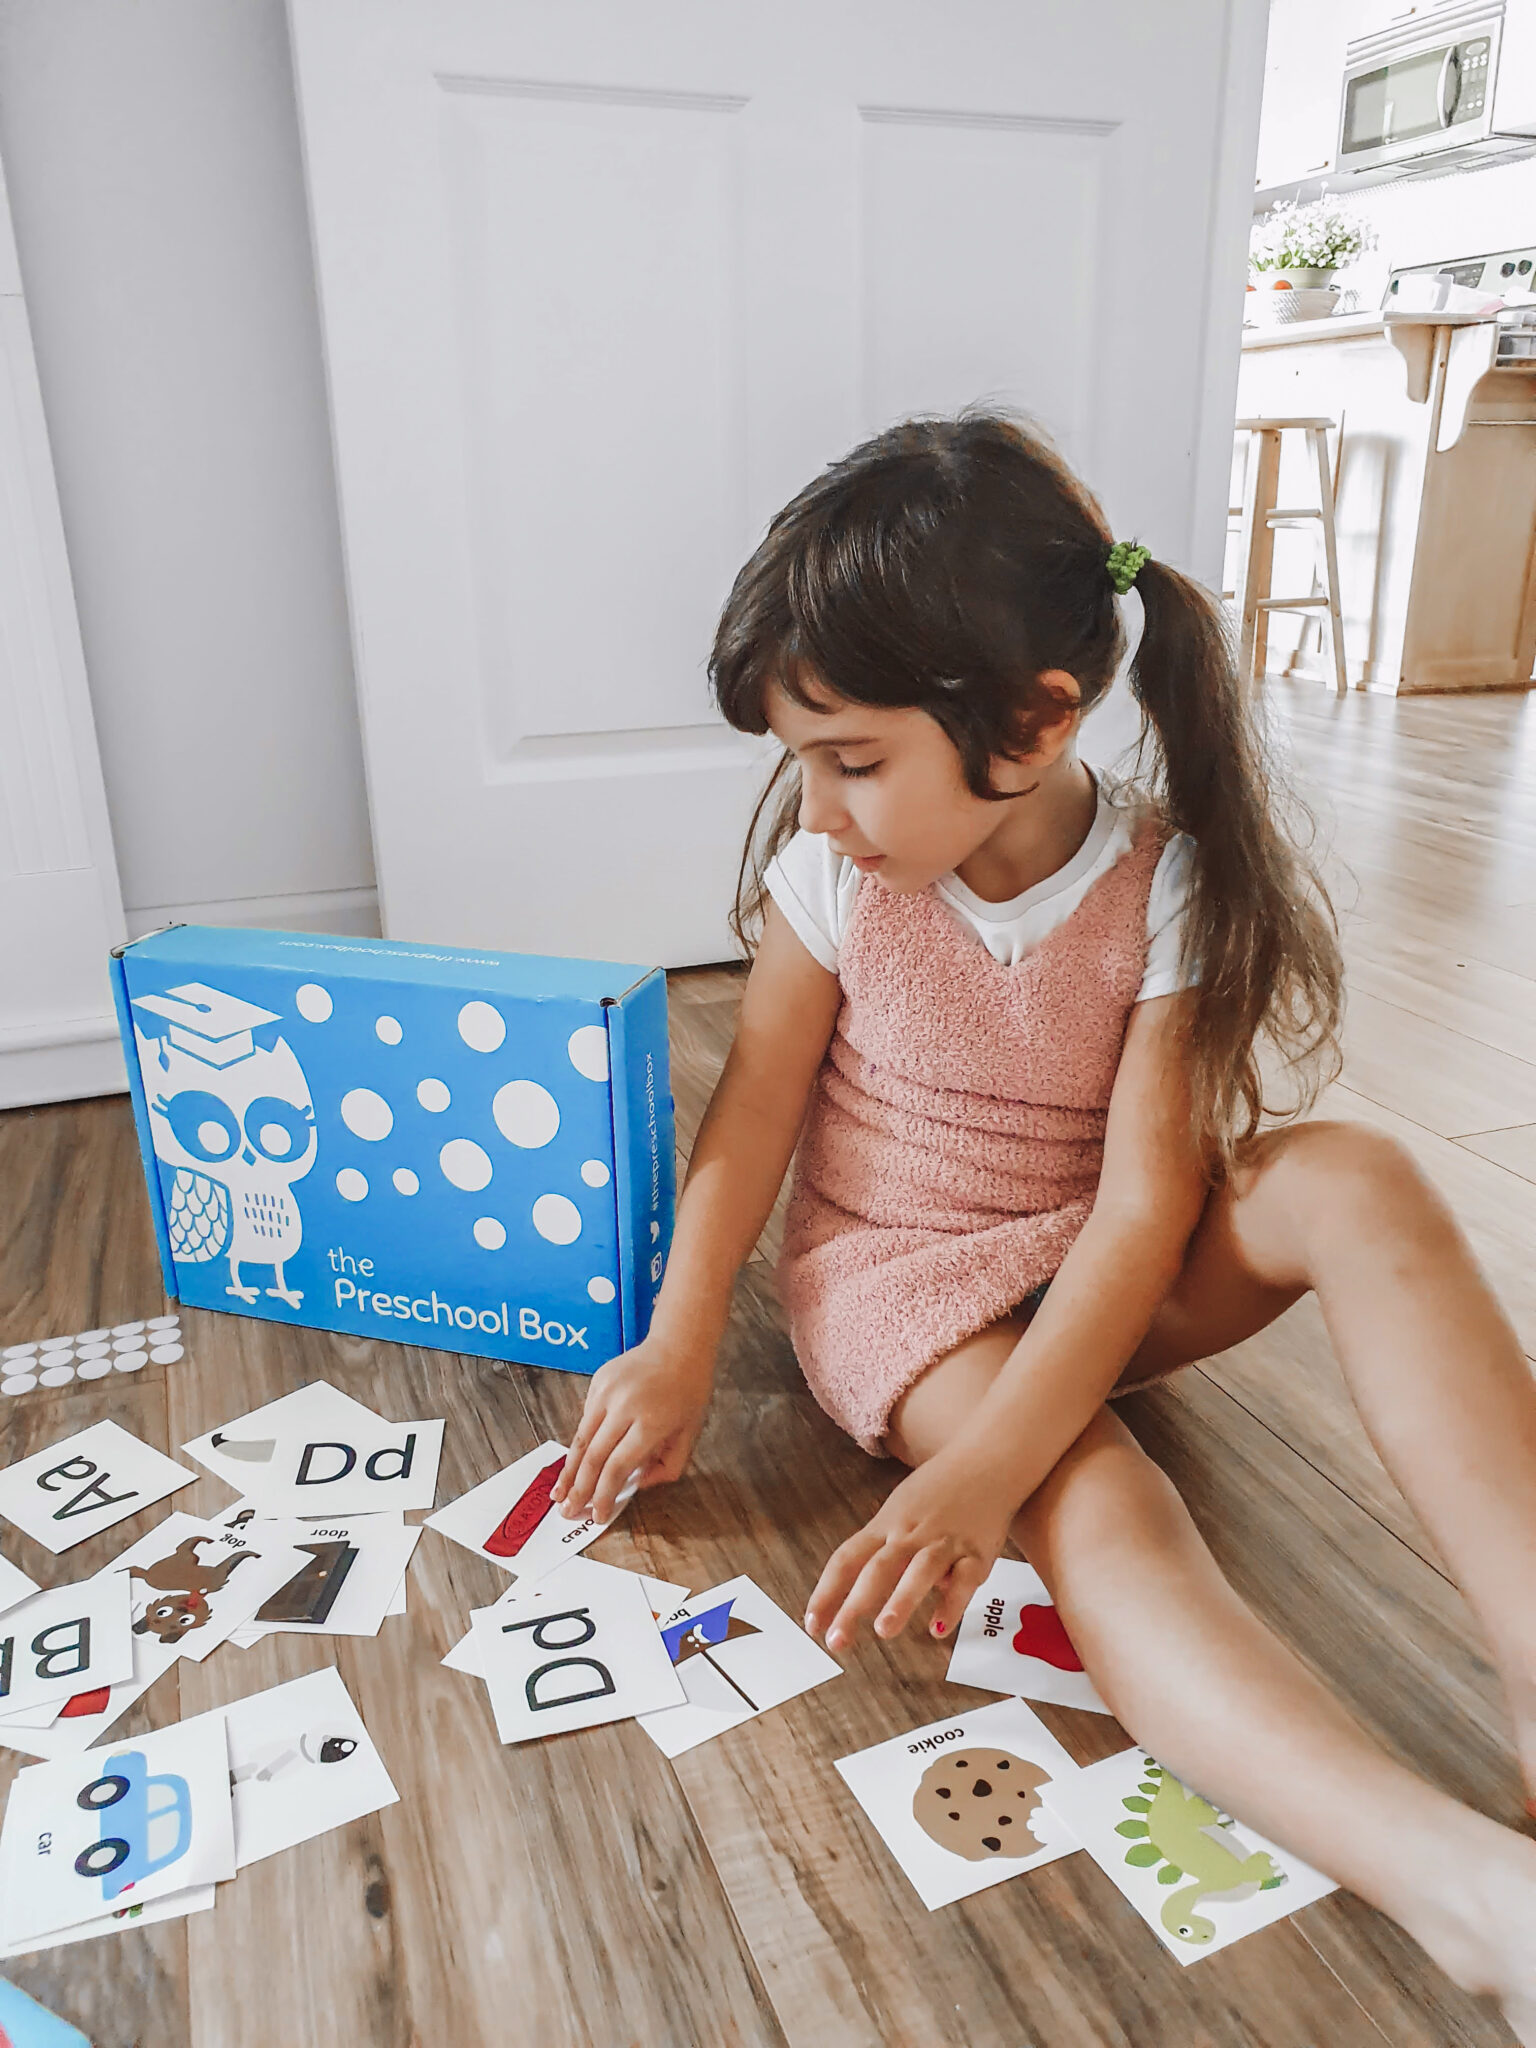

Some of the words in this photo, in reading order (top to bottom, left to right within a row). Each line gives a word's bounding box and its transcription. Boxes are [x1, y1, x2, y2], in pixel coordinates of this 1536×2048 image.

[327, 1246, 376, 1278] the
[334, 1277, 509, 1336] Preschool
[518, 1307, 590, 1350] Box
[294, 1433, 417, 1486] Dd
[36, 1454, 140, 1521] Aa
[218, 1532, 247, 1549] dog
[309, 1527, 350, 1540] door
[561, 1518, 596, 1545] crayo
[983, 1596, 1006, 1639] apple
[501, 1606, 617, 1712] Dd
[906, 1727, 966, 1755] cookie
[37, 1831, 53, 1857] car
